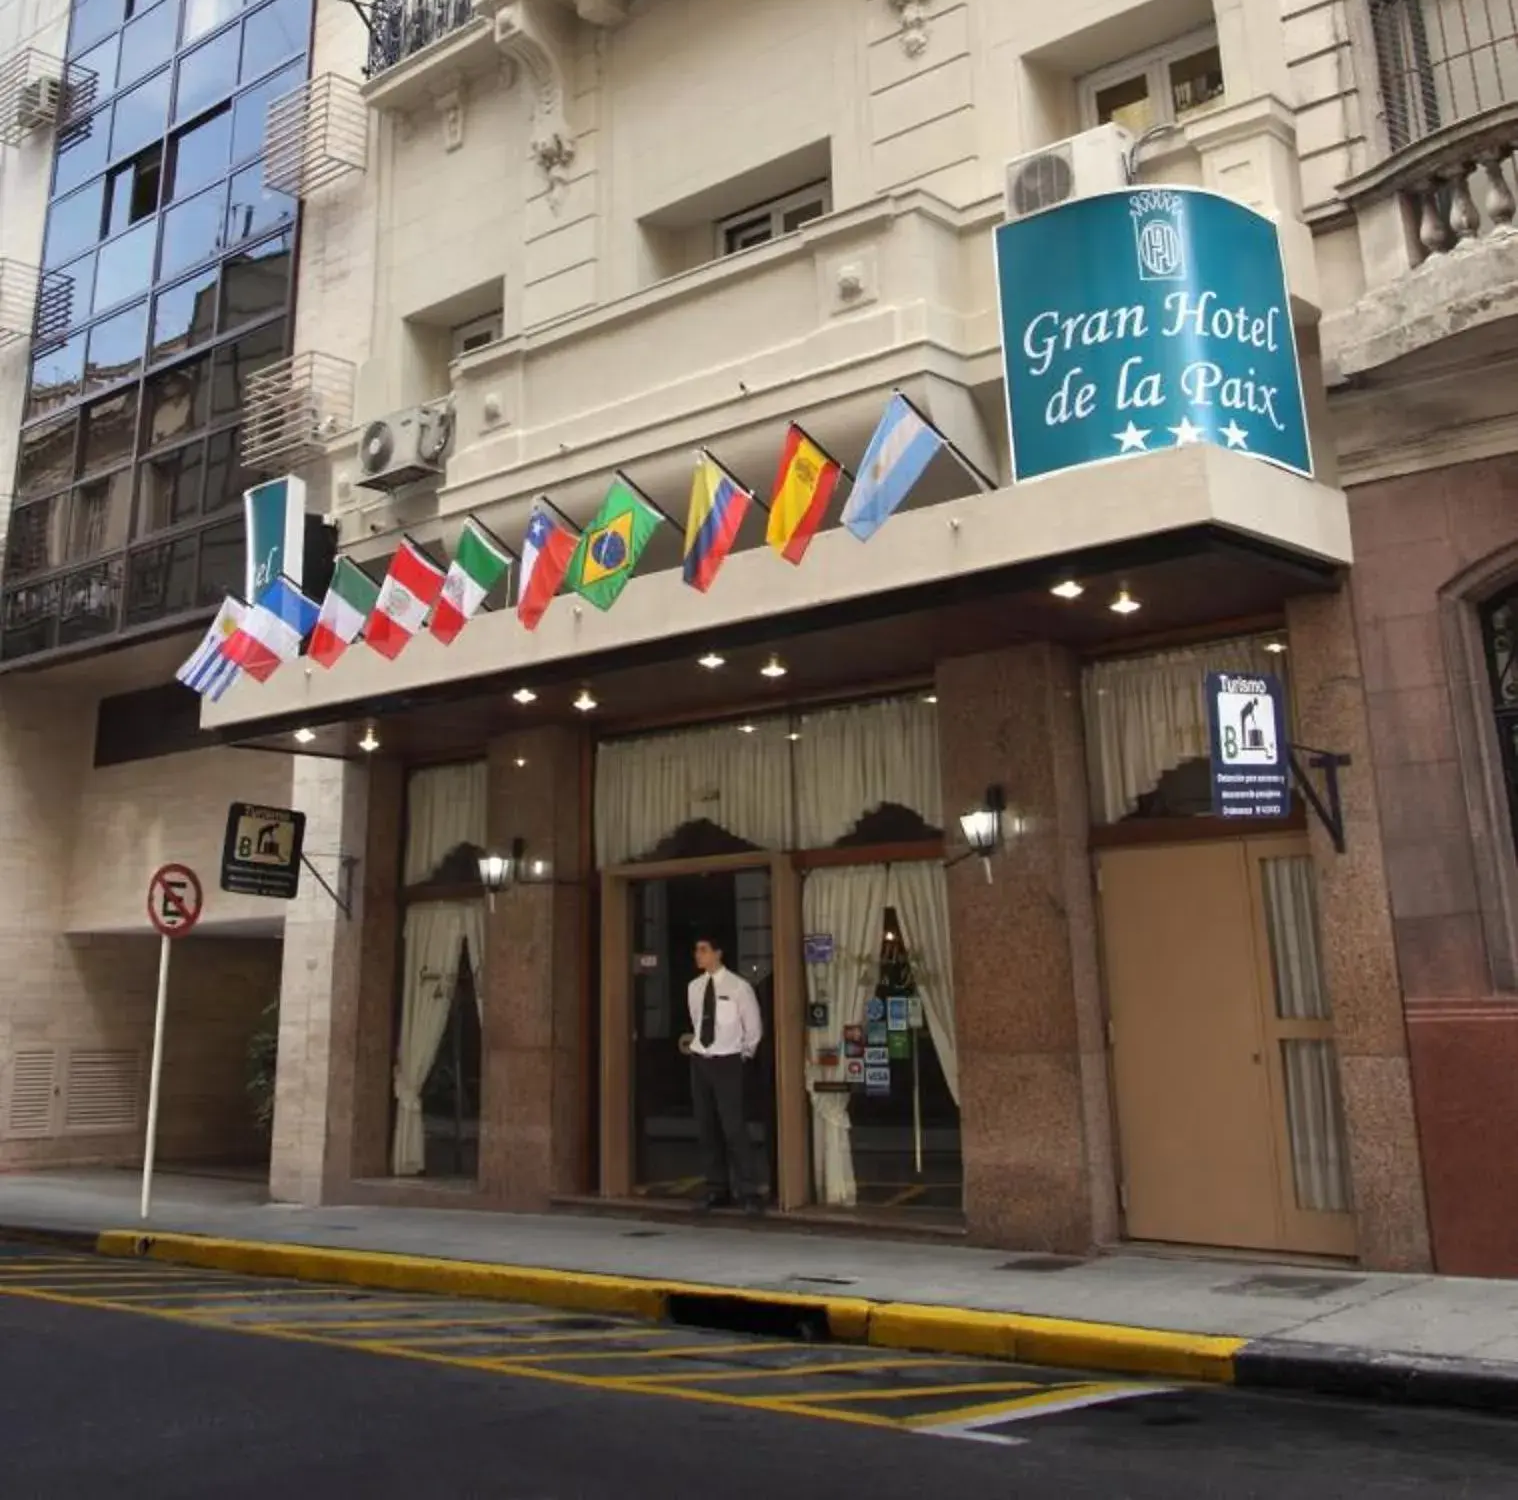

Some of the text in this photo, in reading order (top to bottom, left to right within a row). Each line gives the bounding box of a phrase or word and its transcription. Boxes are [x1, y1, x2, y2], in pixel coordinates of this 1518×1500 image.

[1023, 291, 1280, 375] Gran Hotel
[1045, 356, 1286, 431] de la Paix
[1219, 673, 1267, 694] Turismo
[1224, 725, 1238, 759] B
